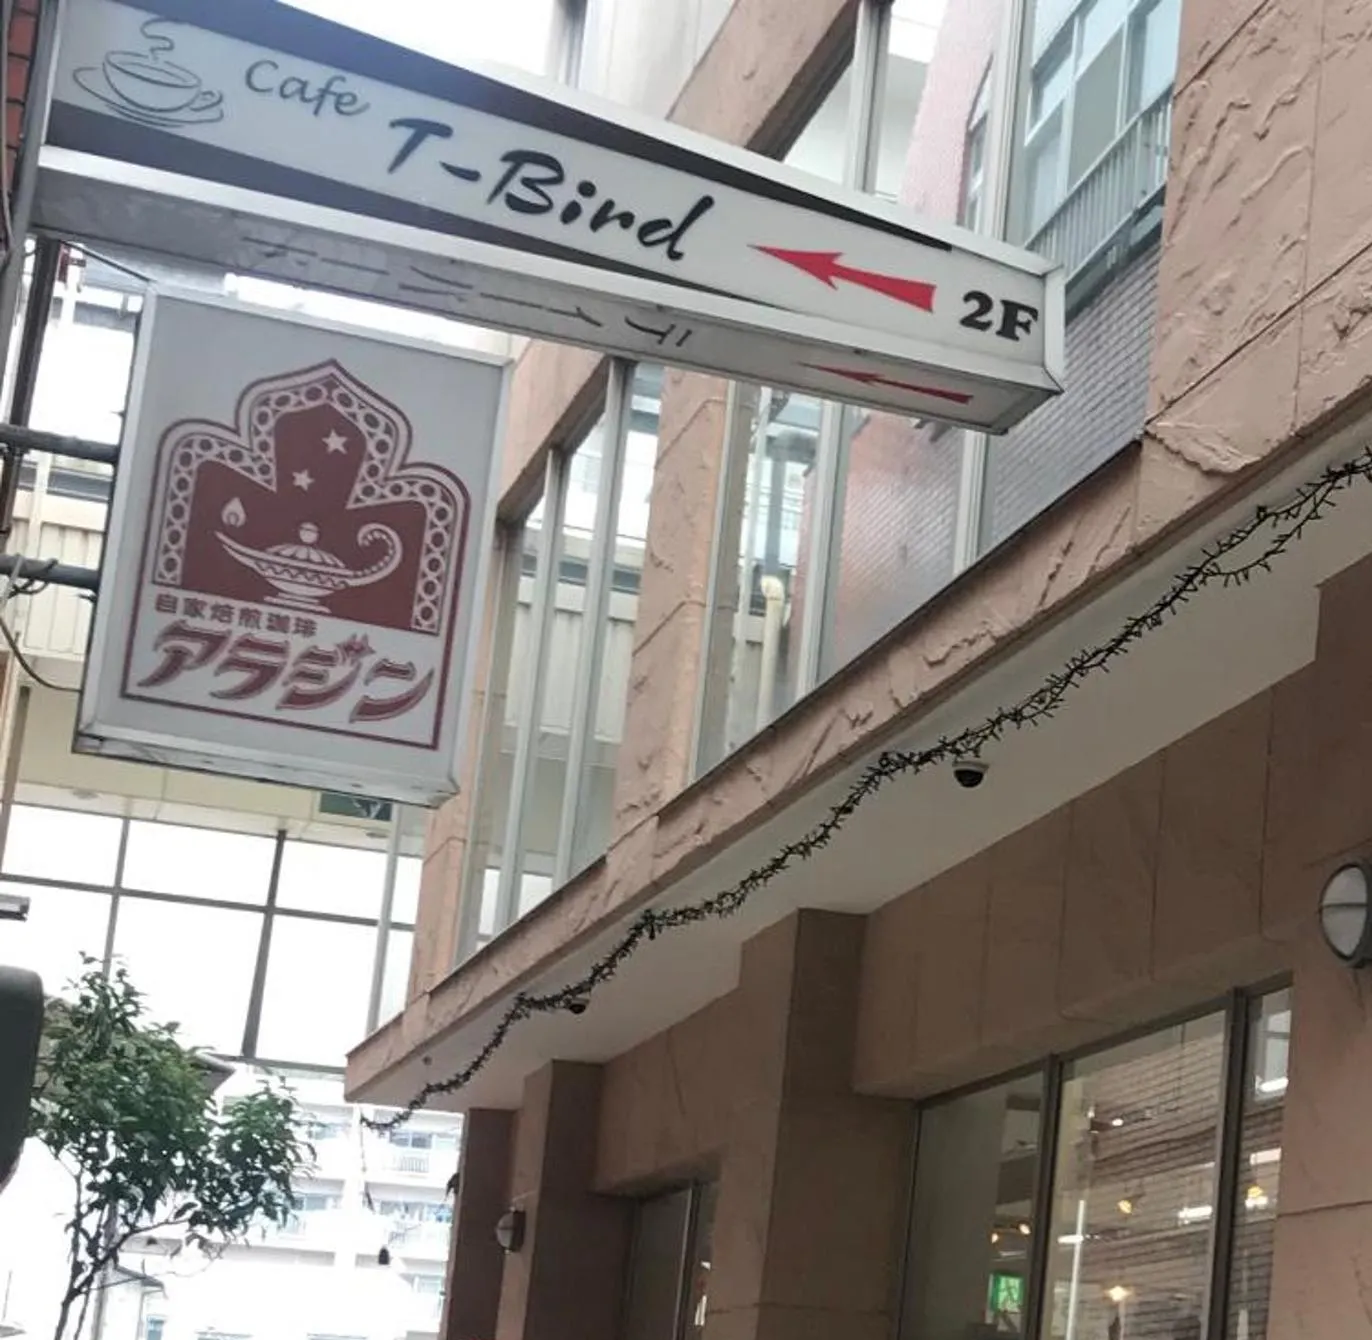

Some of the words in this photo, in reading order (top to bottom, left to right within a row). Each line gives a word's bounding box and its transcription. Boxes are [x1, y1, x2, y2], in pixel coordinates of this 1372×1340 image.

[387, 117, 716, 262] T-Bird
[958, 289, 1039, 342] 2F
[154, 592, 319, 639] 自家焙煎珈琲
[136, 619, 436, 724] アラジン
